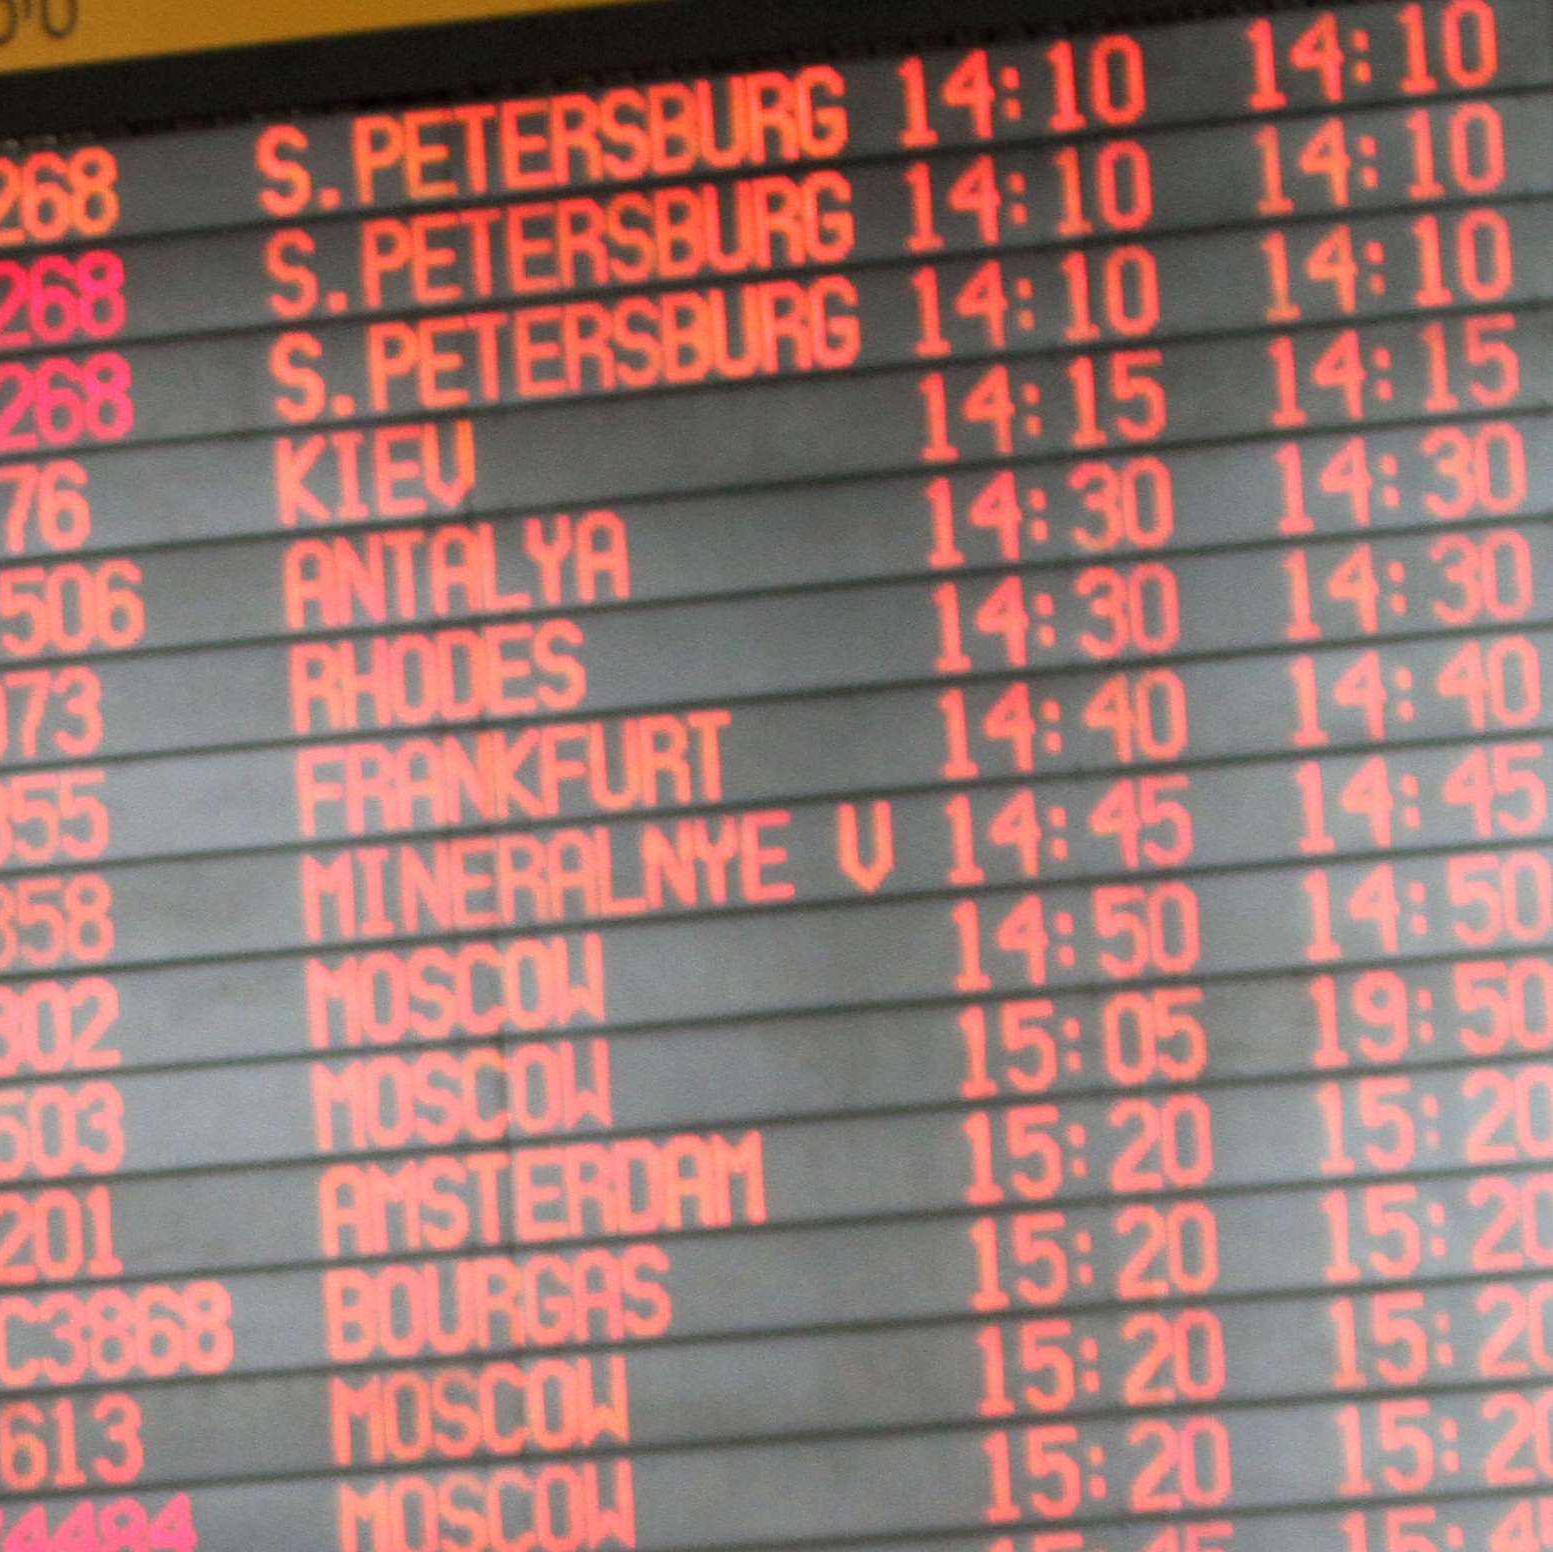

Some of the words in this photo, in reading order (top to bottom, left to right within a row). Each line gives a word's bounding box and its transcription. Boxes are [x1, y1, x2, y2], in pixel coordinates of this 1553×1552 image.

[256, 64, 851, 217] S.PETERSBURG
[898, 33, 1148, 148] 14:10
[266, 169, 856, 318] S.PETERSBURG
[905, 140, 1155, 253] 14:10
[277, 419, 477, 525] KIEV
[920, 350, 1168, 461] 14:15
[1270, 313, 1520, 426] 14:15
[285, 510, 631, 628] ANTALYA
[926, 457, 1175, 568] 14:30
[291, 619, 587, 732] RHODES
[934, 563, 1181, 673] 14:30
[1286, 531, 1533, 639] 14:30
[298, 709, 732, 833] FRANKFURT
[940, 670, 1188, 779] 14:40
[1291, 634, 1543, 747] 14:40
[304, 810, 796, 938] MINERALNYE
[840, 801, 895, 891] V
[947, 776, 1193, 884] 14:45
[1297, 742, 1548, 854] 14:45
[308, 933, 605, 1047] MOSCOW
[954, 882, 1201, 991] 14:50
[1304, 850, 1553, 962] 14:50
[314, 1039, 613, 1149] MOSCOW
[960, 988, 1207, 1098] 15:05
[1309, 957, 1553, 1069] 19:50
[321, 1131, 768, 1255] AMSTERDAM
[964, 1094, 1214, 1205] 15:20
[326, 1244, 673, 1360] BOURGAS
[972, 1202, 1219, 1312] 15:20
[332, 1356, 630, 1465] MOSCOW
